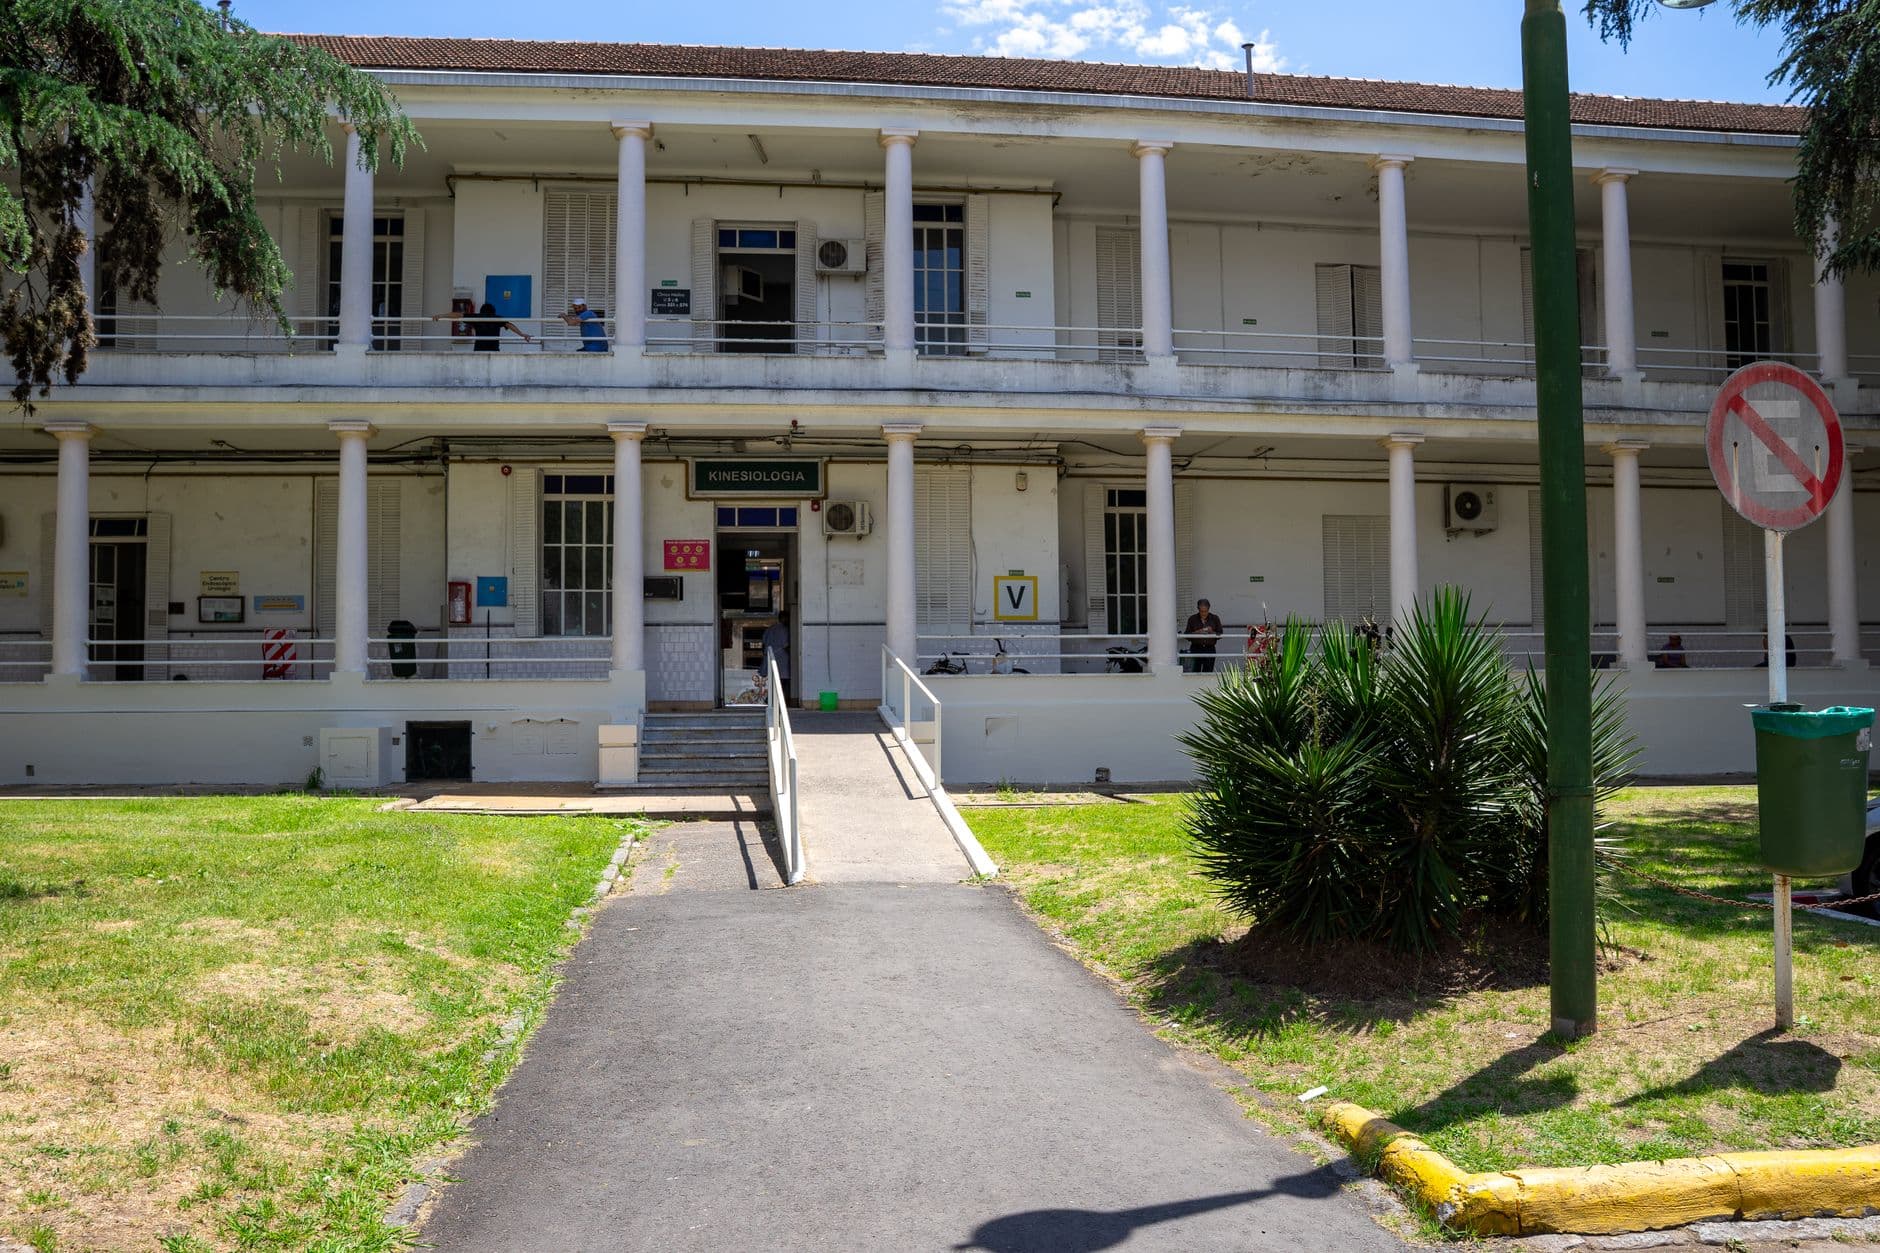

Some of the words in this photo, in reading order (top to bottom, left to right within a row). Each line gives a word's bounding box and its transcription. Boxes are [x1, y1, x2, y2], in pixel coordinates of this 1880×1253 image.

[1749, 399, 1800, 492] E
[708, 470, 805, 481] KINESIOLOGIA
[1006, 585, 1026, 609] V
